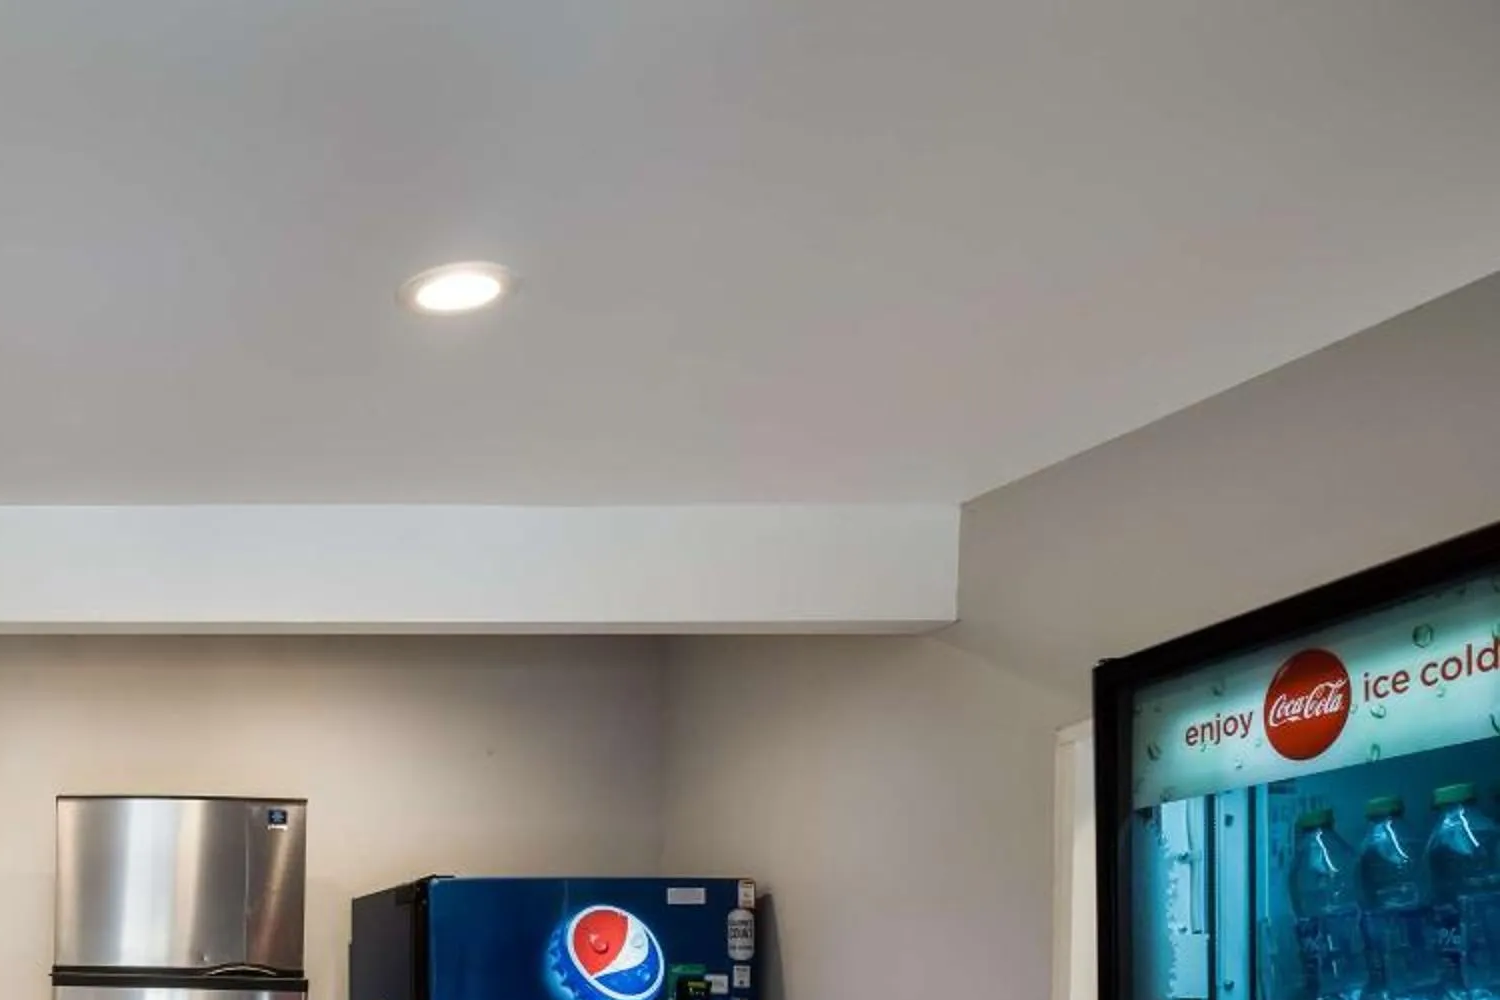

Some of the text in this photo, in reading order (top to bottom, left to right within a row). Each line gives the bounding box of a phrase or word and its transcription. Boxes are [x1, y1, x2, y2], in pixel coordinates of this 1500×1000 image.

[1186, 711, 1253, 747] enjoy
[1364, 670, 1410, 702] ice
[1420, 637, 1499, 686] cold
